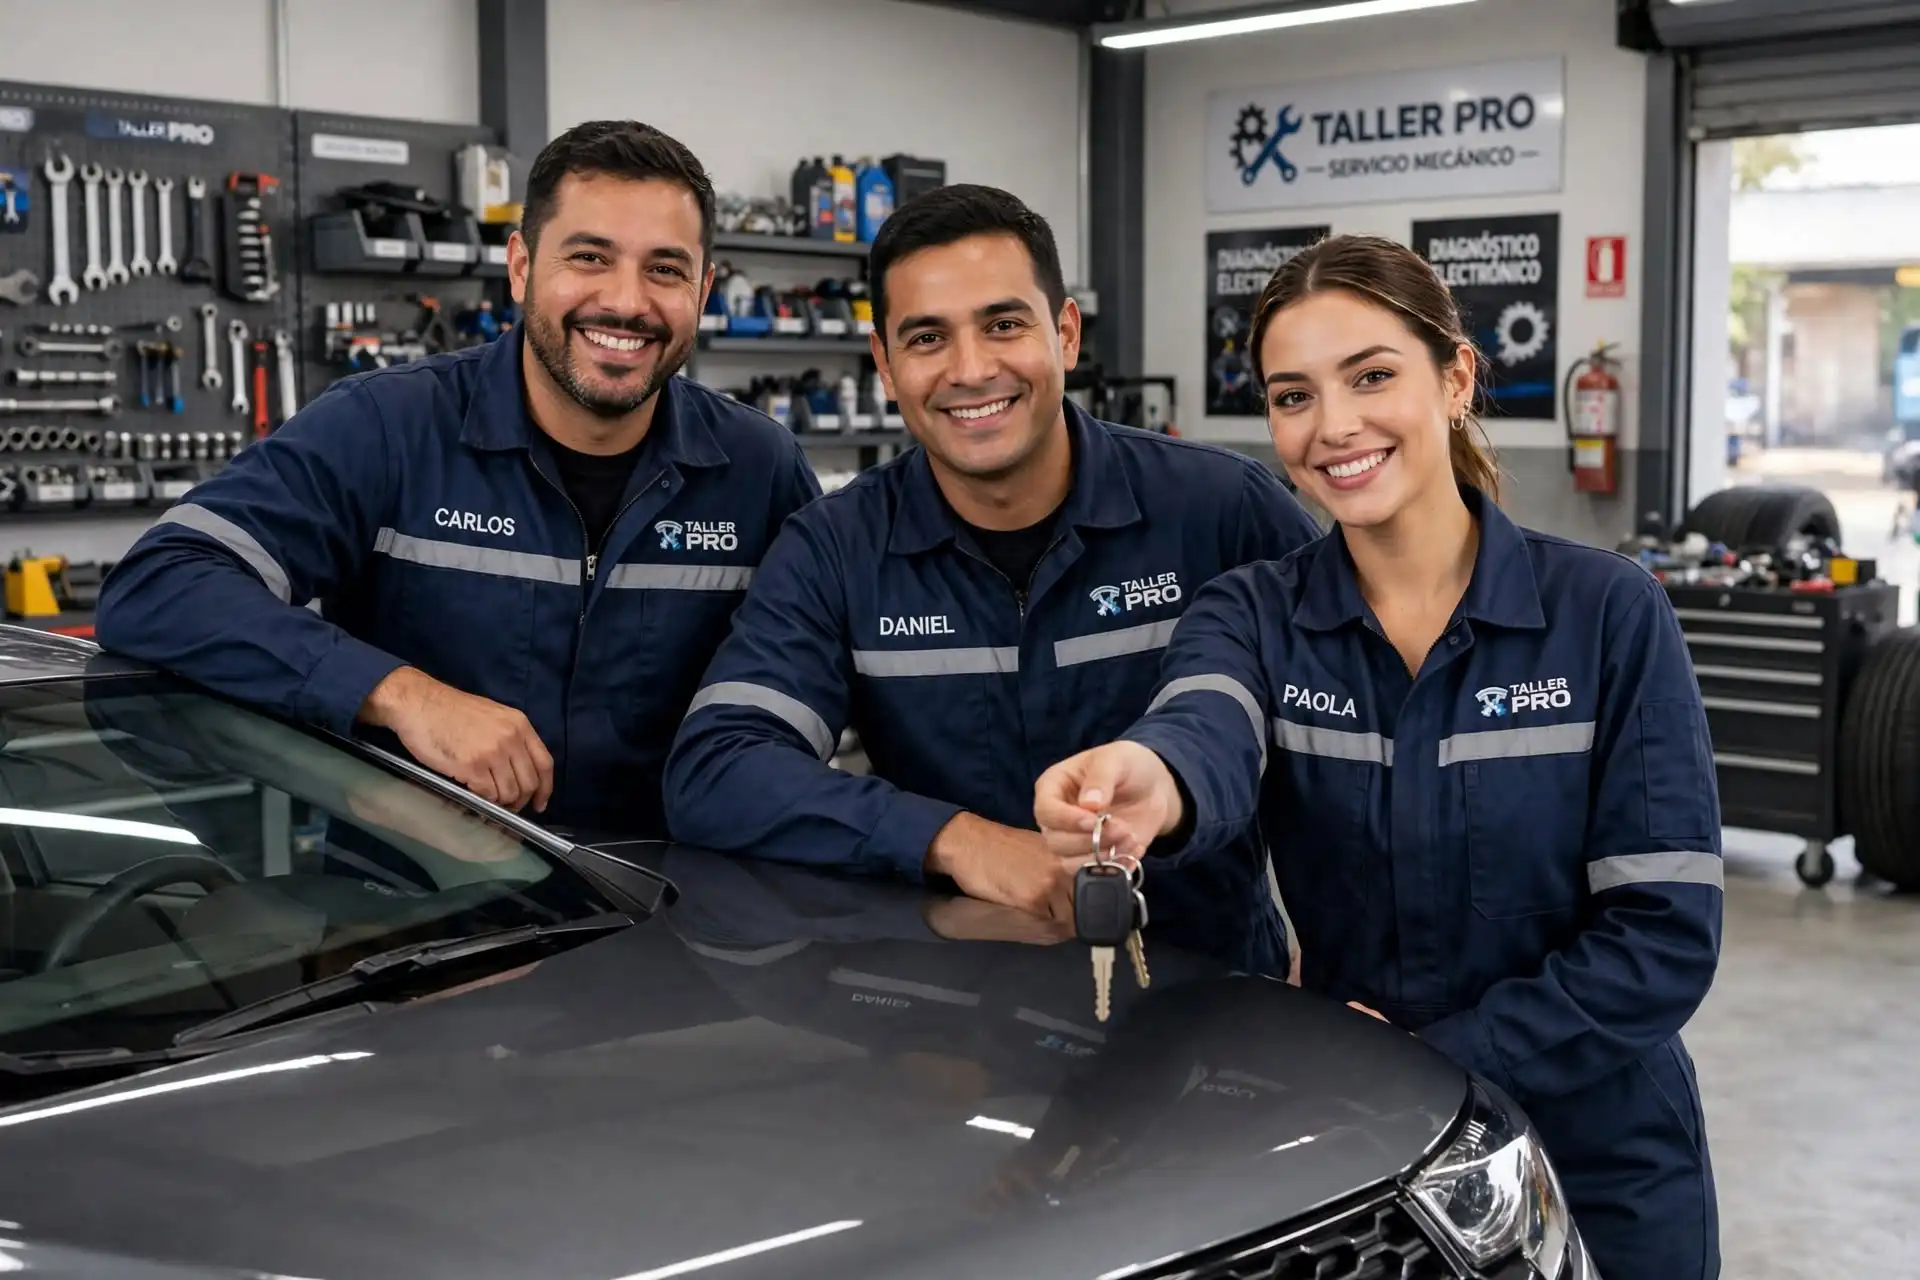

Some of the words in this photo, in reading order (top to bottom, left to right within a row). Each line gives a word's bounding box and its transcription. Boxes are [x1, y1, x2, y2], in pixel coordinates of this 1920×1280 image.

[1312, 103, 1443, 145] TALLER
[1454, 93, 1536, 134] PRO
[168, 120, 215, 146] PRO
[1328, 152, 1409, 179] SERVICIO
[1413, 144, 1515, 171] MECÁNICO
[1429, 229, 1540, 262] DIAGNÓSTICO
[434, 507, 516, 537] CARLOS
[685, 520, 736, 533] TALLER
[686, 533, 738, 551] PRO
[1121, 571, 1178, 591] TALLER
[1124, 584, 1182, 611] PRO
[879, 615, 955, 636] DANIEL
[1509, 677, 1568, 696] TALLER
[1282, 684, 1357, 719] PAOLA
[1511, 689, 1571, 713] PRO
